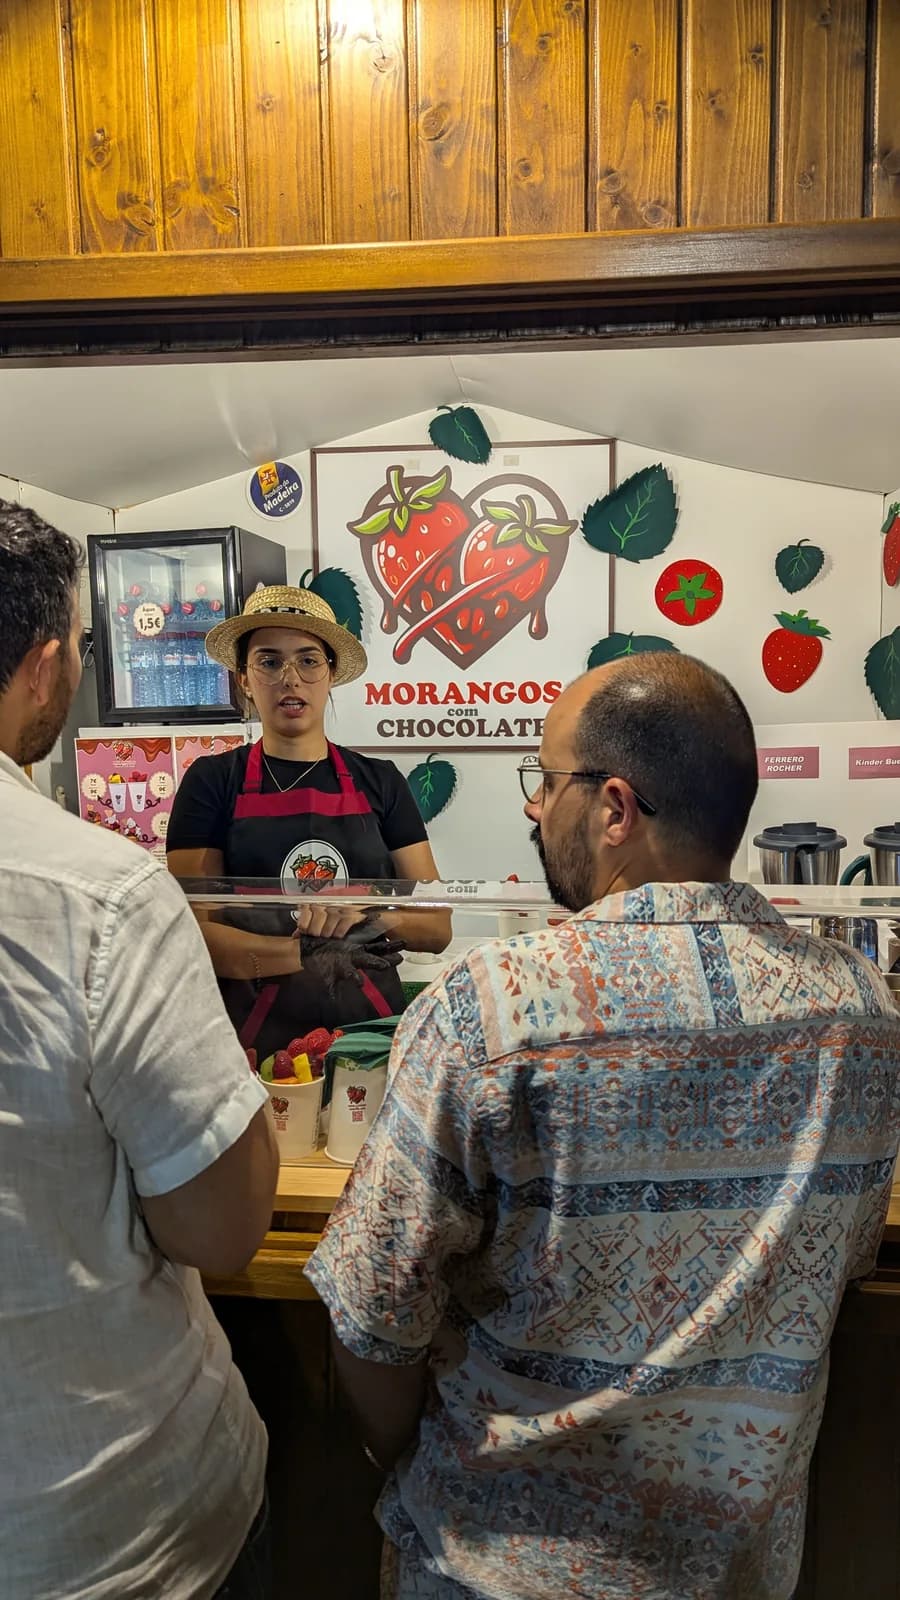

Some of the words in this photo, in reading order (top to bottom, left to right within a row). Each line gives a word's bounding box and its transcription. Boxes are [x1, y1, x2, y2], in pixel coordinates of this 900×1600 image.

[263, 482, 299, 513] Madeira
[139, 617, 160, 631] 1,5€
[365, 681, 562, 705] MORANGOS
[447, 707, 479, 717] com
[764, 756, 805, 764] FERRERO
